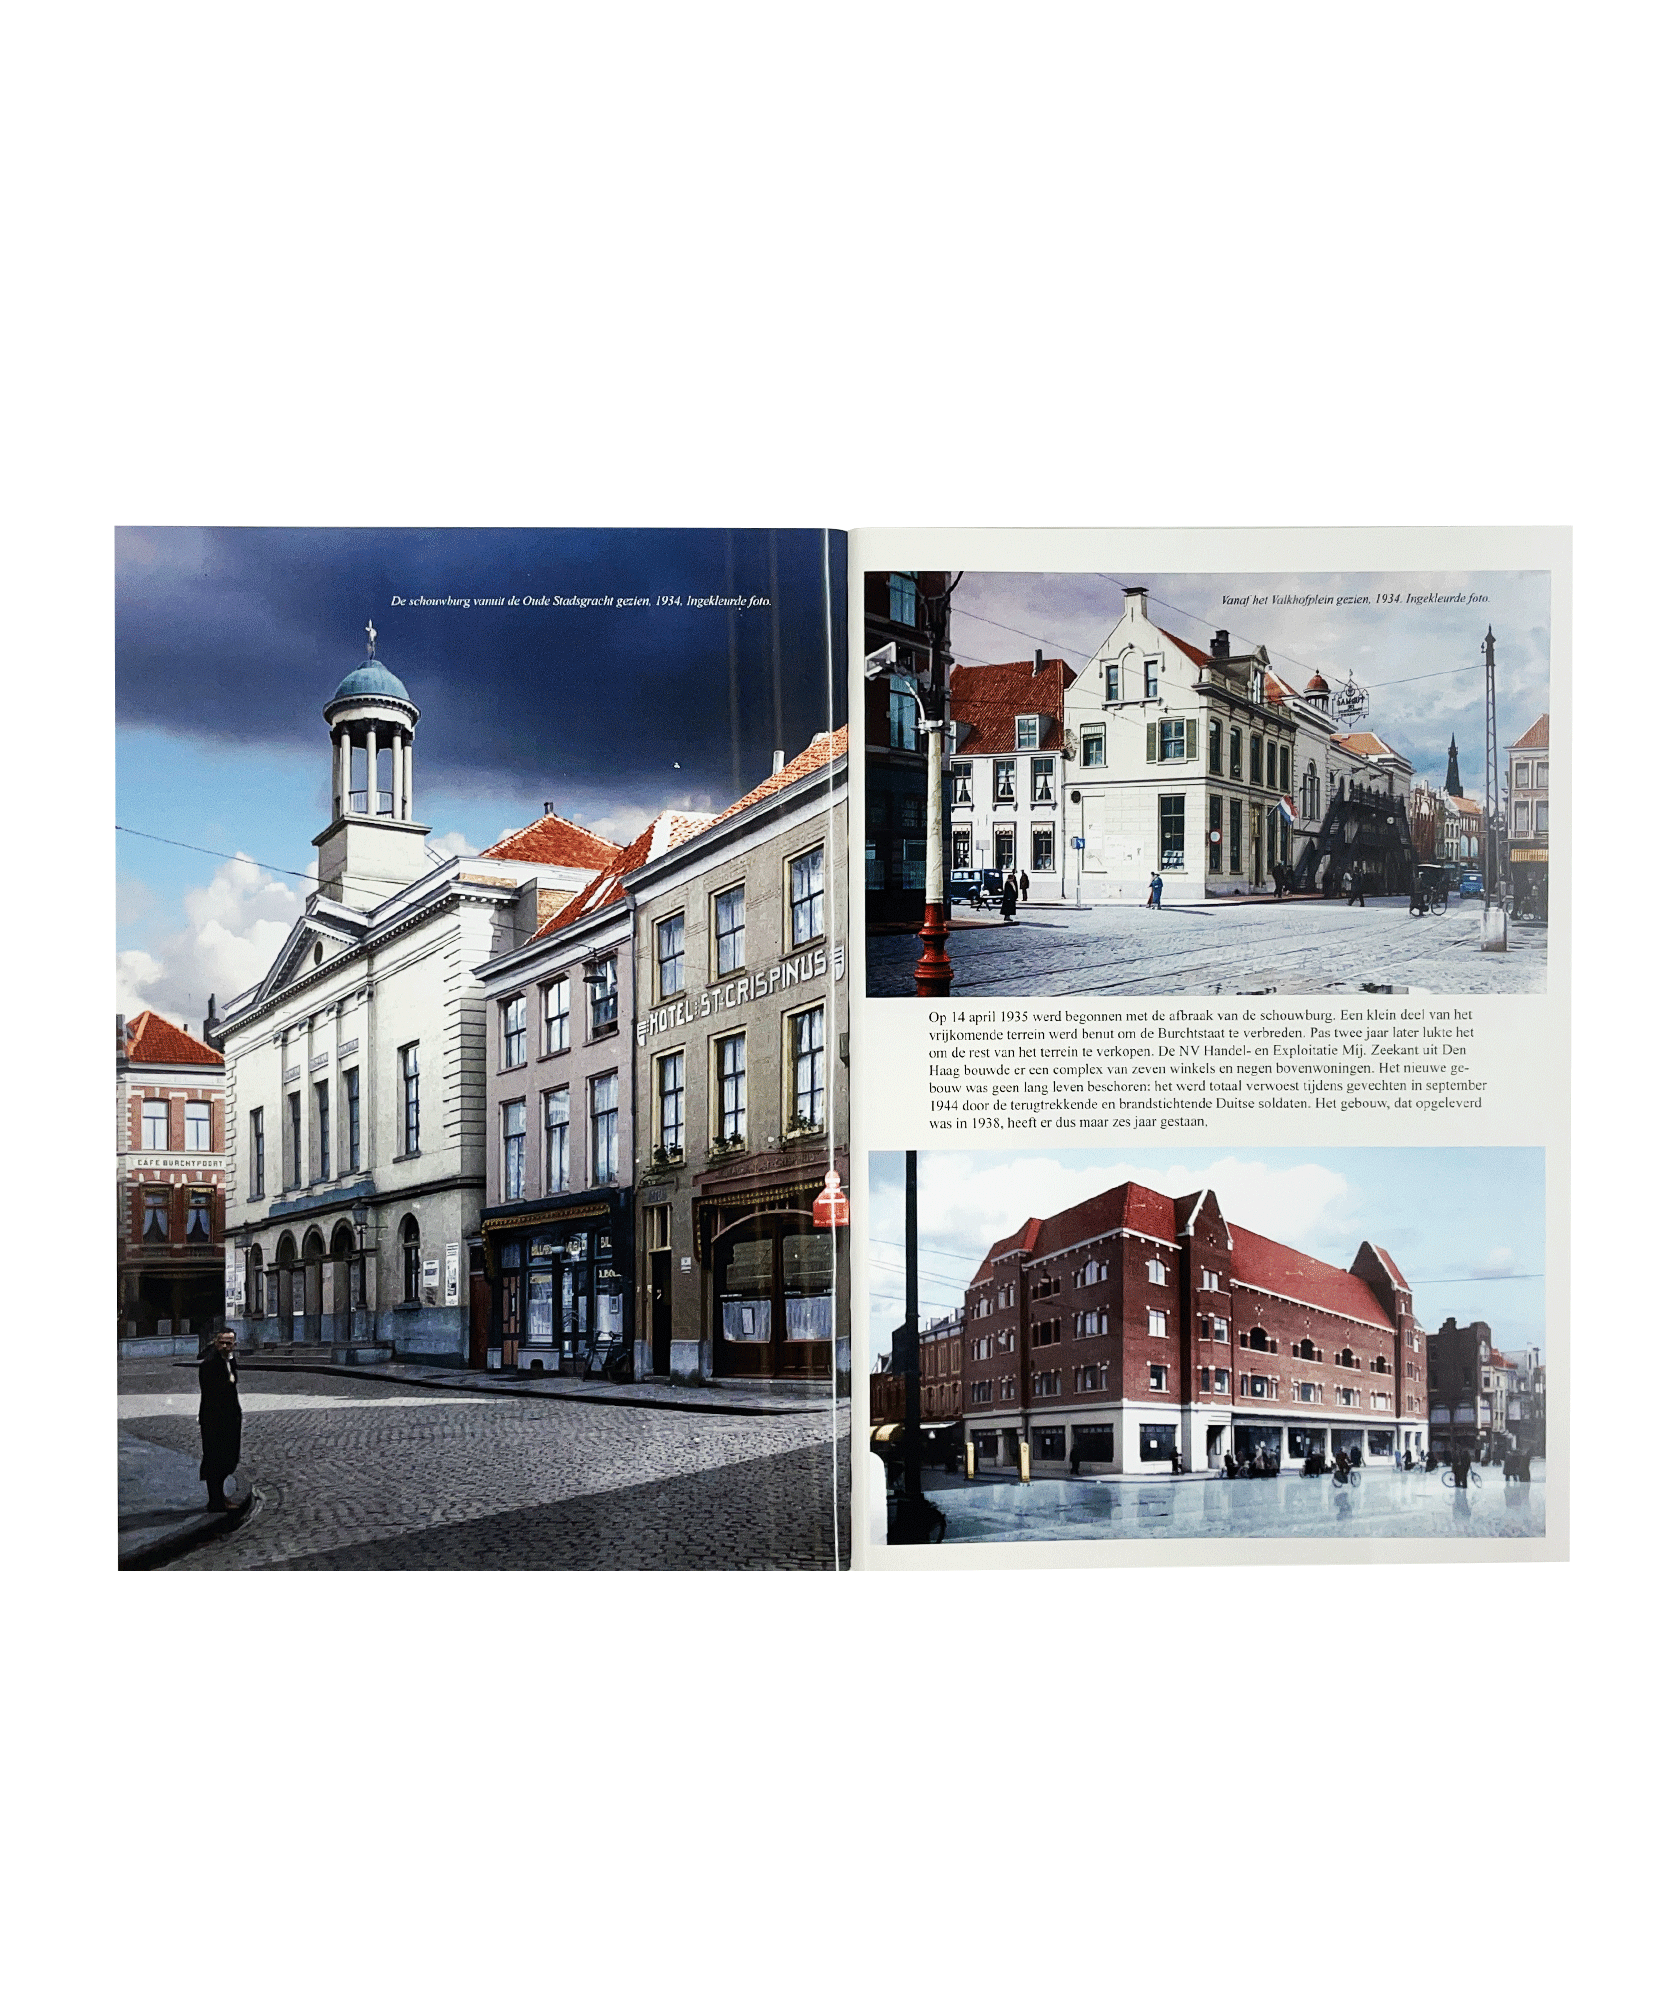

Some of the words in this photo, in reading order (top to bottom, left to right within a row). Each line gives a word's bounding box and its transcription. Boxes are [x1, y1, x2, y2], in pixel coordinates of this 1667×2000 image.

[390, 596, 407, 606] De
[409, 596, 471, 608] schouwburg
[473, 597, 505, 605] vanuit
[507, 596, 521, 605] de
[522, 596, 551, 605] Oude
[552, 596, 614, 608] Stadsgracht
[615, 596, 651, 608] gezien,
[656, 596, 683, 606] 1934.
[687, 595, 747, 608] Ingekleurde
[747, 596, 772, 608] foto.
[1222, 595, 1252, 607] Vanaf
[1252, 595, 1269, 605] het
[1272, 594, 1334, 606] Valkhofplein
[1336, 595, 1371, 606] gezien,
[1376, 593, 1402, 604] 1934.
[1406, 593, 1466, 604] Ingekleurde
[1467, 593, 1490, 605] foto.
[649, 1000, 694, 1036] HOTEL
[725, 948, 827, 1008] CRISPINUS
[929, 1012, 946, 1025] Op
[953, 1012, 965, 1022] 14
[969, 1011, 995, 1025] april
[1002, 1011, 1027, 1023] 1935
[1033, 1011, 1061, 1021] werd
[1065, 1011, 1122, 1024] begonnen
[1126, 1012, 1148, 1021] met
[1152, 1010, 1165, 1021] de
[1169, 1010, 1213, 1021] afbraak
[1243, 1010, 1255, 1021] de
[1260, 1009, 1335, 1023] schouwburg.
[1341, 1010, 1362, 1020] Een
[1367, 1009, 1396, 1020] klein
[1401, 1009, 1424, 1020] deel
[1429, 1012, 1449, 1020] van
[1454, 1009, 1472, 1020] het
[929, 1029, 1003, 1043] vrijkomende
[1007, 1031, 1044, 1040] terrein
[1049, 1029, 1077, 1039] werd
[1083, 1028, 1114, 1039] benut
[1141, 1028, 1154, 1038] de
[1158, 1027, 1224, 1038] Burchtstaat
[1229, 1029, 1239, 1039] te
[1244, 1027, 1306, 1038] verbreden.
[1311, 1027, 1330, 1037] Pas
[1335, 1030, 1363, 1038] twee
[1364, 1028, 1390, 1041] jaar
[1393, 1027, 1420, 1037] later
[1423, 1027, 1452, 1038] lukte
[1456, 1026, 1474, 1037] het
[929, 1050, 947, 1058] om
[952, 1047, 965, 1058] de
[970, 1049, 990, 1058] rest
[1019, 1047, 1036, 1057] het
[1041, 1046, 1078, 1057] terrein
[1083, 1048, 1092, 1057] te
[1097, 1046, 1154, 1059] verkopen.
[1159, 1046, 1175, 1056] De
[1180, 1046, 1199, 1056] NV
[1205, 1045, 1251, 1056] Handel-
[1274, 1044, 1338, 1058] Exploitatie
[1343, 1044, 1366, 1058] Mij.
[1371, 1044, 1419, 1055] Zeekant
[1423, 1044, 1437, 1055] uit
[1443, 1044, 1466, 1055] Den
[930, 1065, 960, 1078] Haag
[964, 1064, 1010, 1075] bouwde
[1053, 1064, 1103, 1077] complex
[1132, 1067, 1165, 1075] zeven
[1170, 1063, 1215, 1073] winkels
[1237, 1066, 1272, 1076] negen
[1276, 1063, 1374, 1076] bovenwoningen.
[1380, 1063, 1400, 1073] Het
[1404, 1063, 1446, 1072] nieuwe
[1451, 1065, 1469, 1075] ge-
[929, 1082, 961, 1093] bouw
[966, 1085, 988, 1093] was
[992, 1085, 1019, 1096] geen
[1025, 1081, 1048, 1095] lang
[1053, 1081, 1083, 1092] leven
[1088, 1081, 1150, 1092] beschoren:
[1155, 1081, 1172, 1091] het
[1176, 1080, 1205, 1091] werd
[1210, 1080, 1241, 1091] totaal
[1246, 1082, 1299, 1091] verwoest
[1304, 1080, 1343, 1094] tijdens
[1347, 1080, 1406, 1093] gevechten
[1412, 1080, 1422, 1090] in
[1426, 1081, 1487, 1093] september
[932, 1100, 958, 1111] 1944
[963, 1100, 989, 1111] door
[993, 1099, 1007, 1110] de
[1011, 1099, 1097, 1113] terugtrekkende
[1120, 1097, 1212, 1109] brandstichtende
[1216, 1098, 1254, 1108] Duitse
[1259, 1097, 1310, 1108] soldaten.
[1316, 1098, 1336, 1108] Het
[1341, 1097, 1390, 1111] gebouw,
[1395, 1097, 1412, 1108] dat
[1416, 1097, 1482, 1111] opgeleverd
[930, 1121, 952, 1129] was
[957, 1118, 967, 1128] in
[973, 1118, 1003, 1129] 1938,
[1008, 1117, 1036, 1129] heeft
[1056, 1117, 1076, 1127] dus
[1080, 1119, 1109, 1127] maar
[1113, 1119, 1130, 1127] zes
[1133, 1119, 1156, 1129] jaar
[1160, 1117, 1207, 1129] gestaan.
